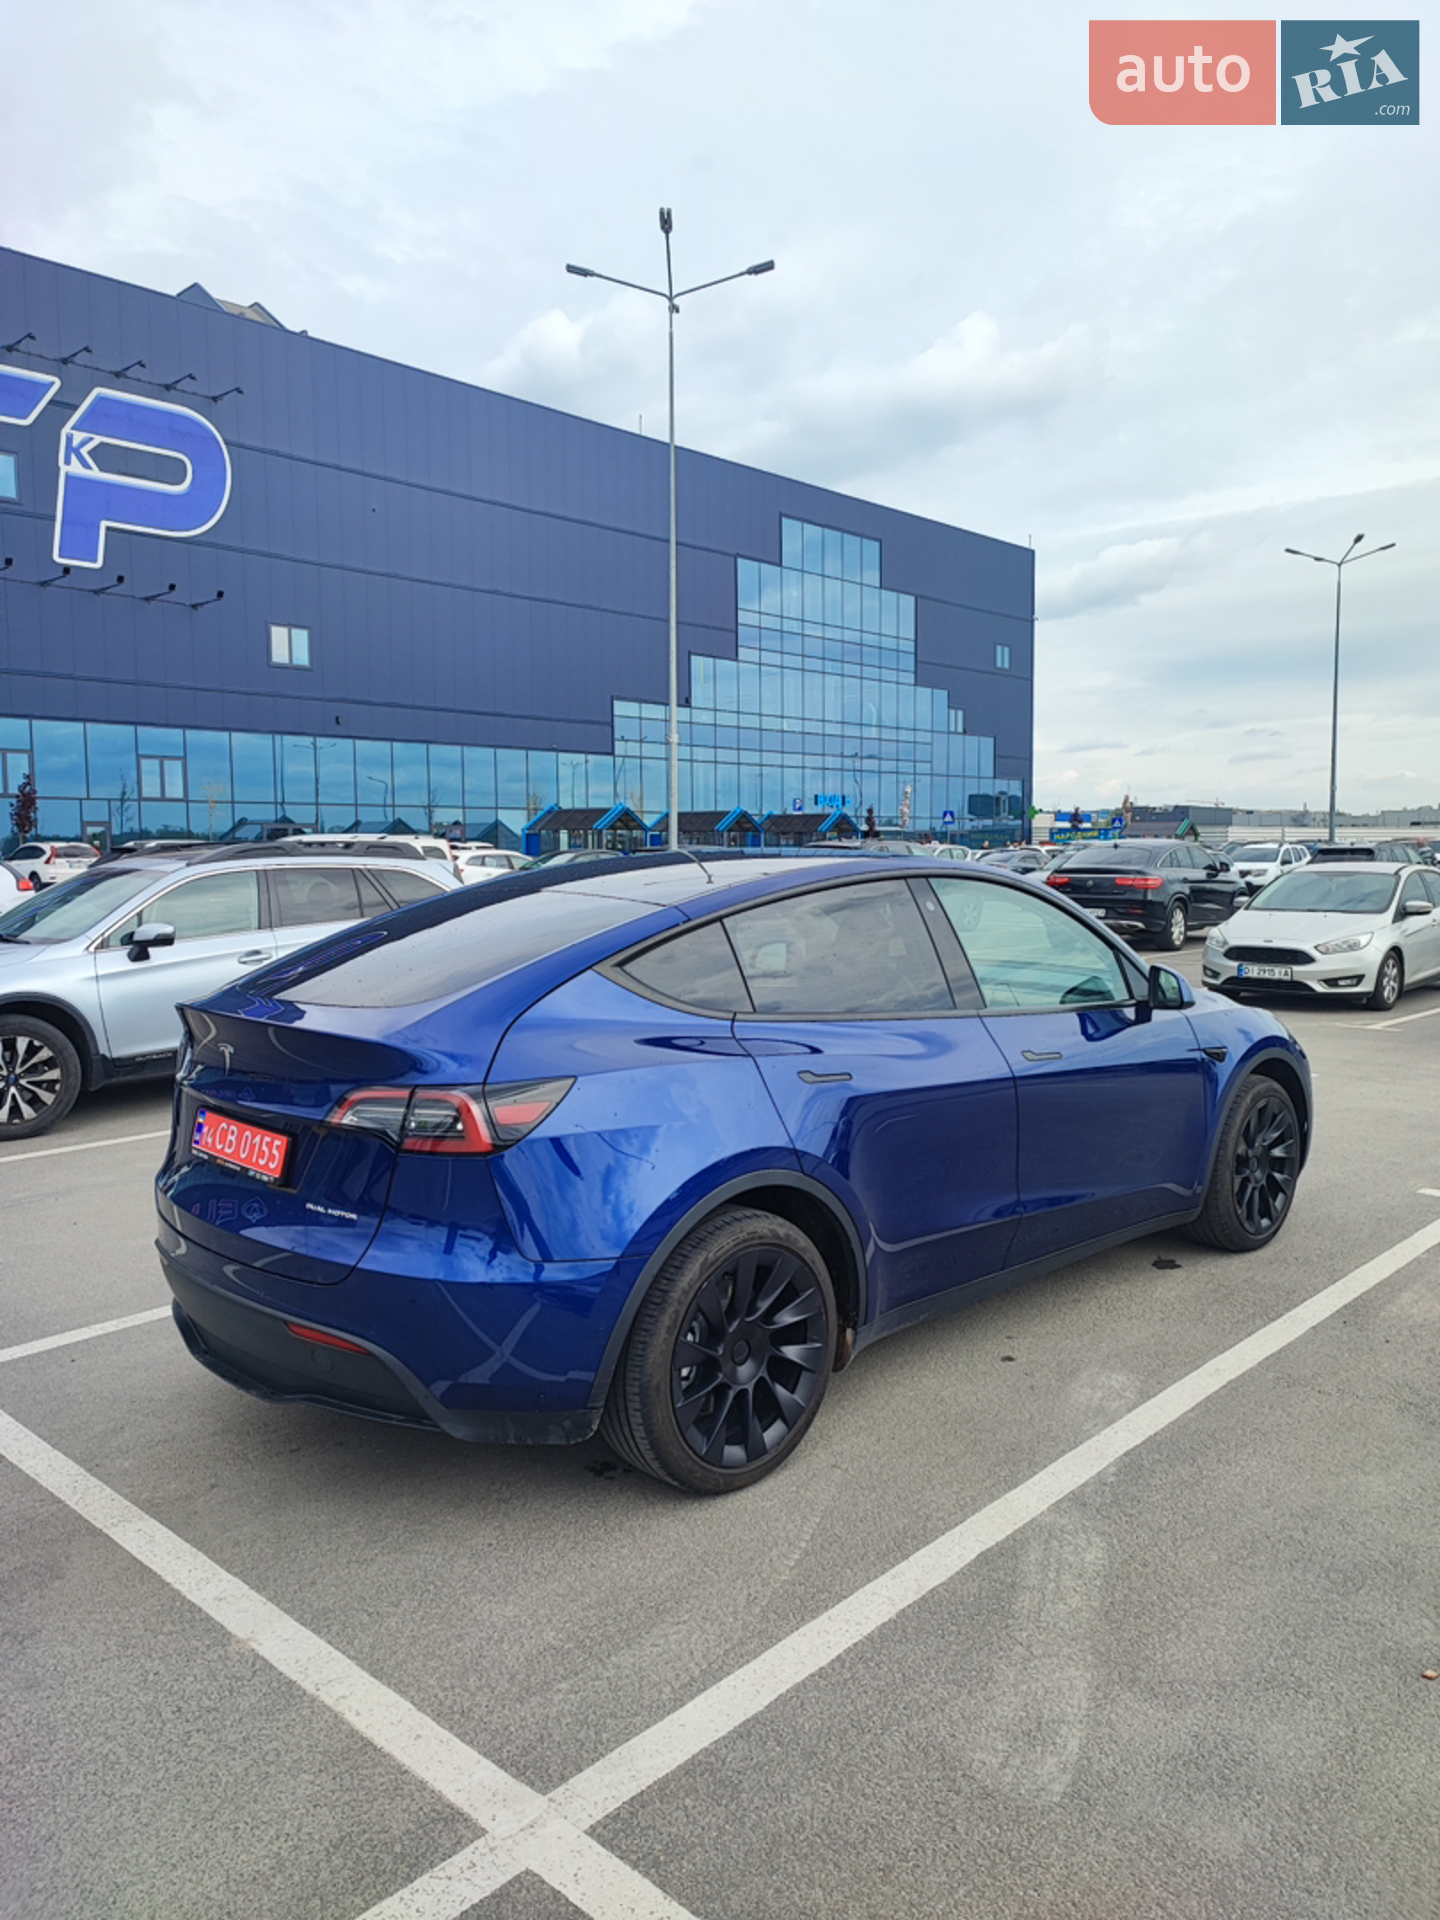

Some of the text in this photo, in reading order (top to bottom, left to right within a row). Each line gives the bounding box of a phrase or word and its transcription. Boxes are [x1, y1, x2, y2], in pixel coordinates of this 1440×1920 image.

[215, 1122, 238, 1154] CB
[239, 1130, 282, 1170] 0155
[305, 1202, 358, 1220] DUAL MOTOR
